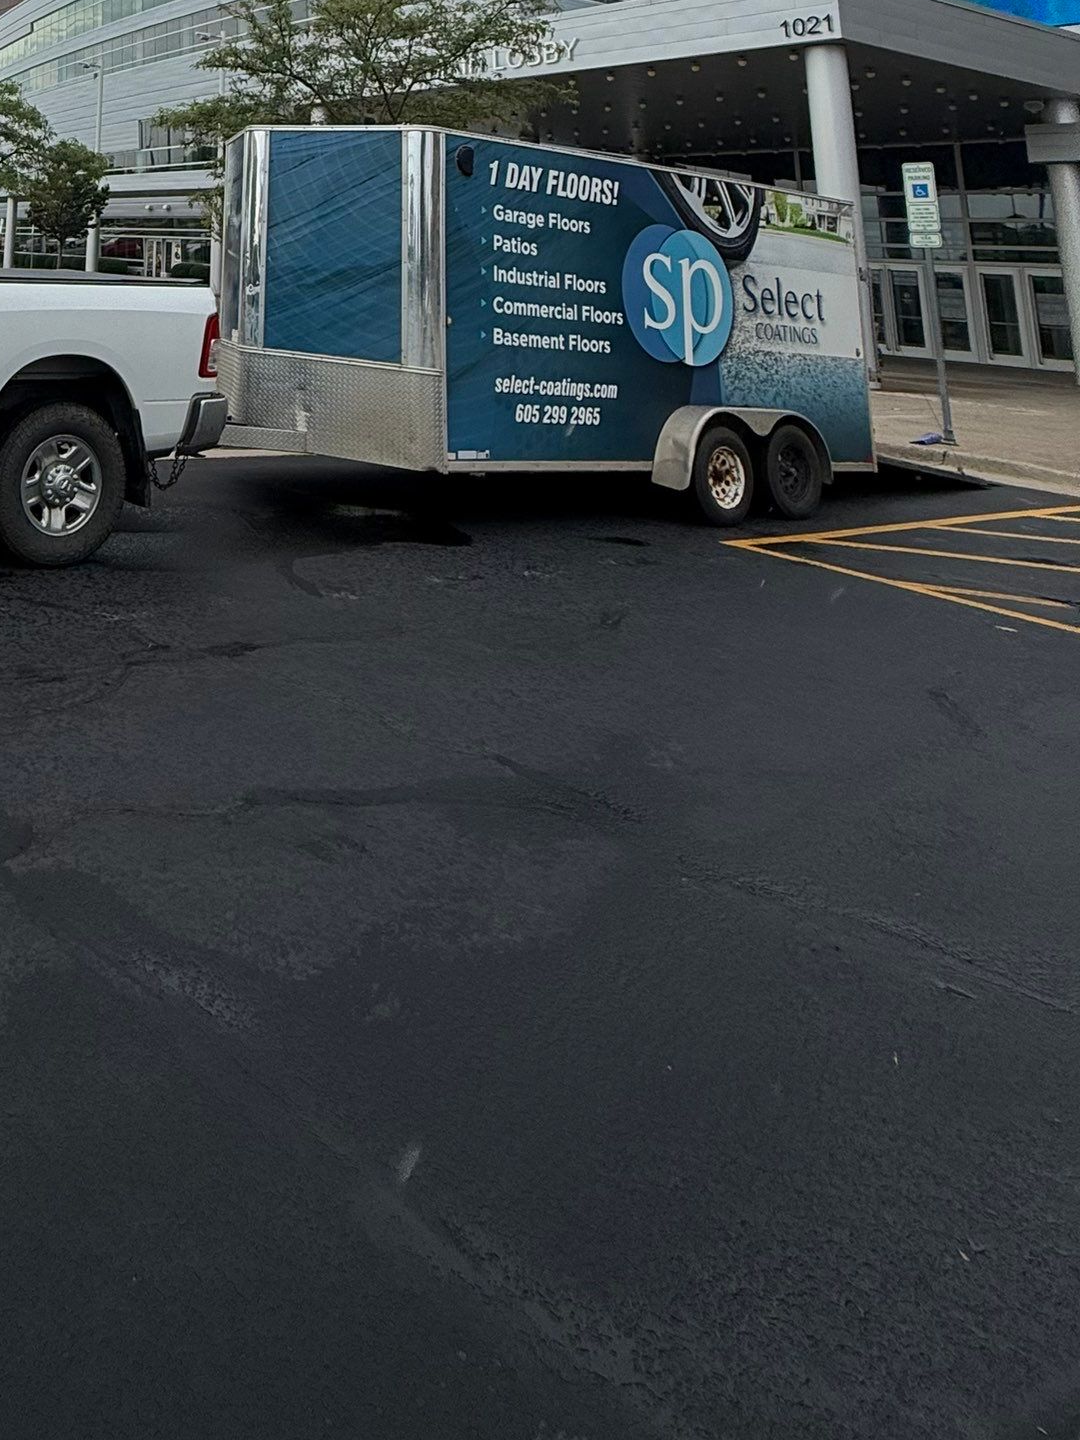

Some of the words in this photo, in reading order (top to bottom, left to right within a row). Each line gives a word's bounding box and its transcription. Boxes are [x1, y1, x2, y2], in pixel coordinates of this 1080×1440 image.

[780, 13, 834, 38] 1021
[489, 160, 499, 186] 1
[505, 162, 543, 192] DAY
[546, 169, 620, 206] FLOORS!
[493, 204, 545, 229] Garage
[548, 213, 591, 234] Floors
[493, 234, 538, 256] Patios
[493, 265, 560, 290] Industrial
[564, 273, 607, 294] Floors
[493, 296, 578, 321] Commercial
[581, 305, 624, 325] Floors
[742, 274, 825, 322] Select
[493, 328, 565, 350] Basement
[569, 334, 611, 354] Floors
[755, 322, 818, 345] COATINGS
[495, 375, 618, 401] select-coatings.com
[515, 404, 540, 424] 605
[542, 405, 567, 425] 299
[570, 406, 601, 426] 2965
